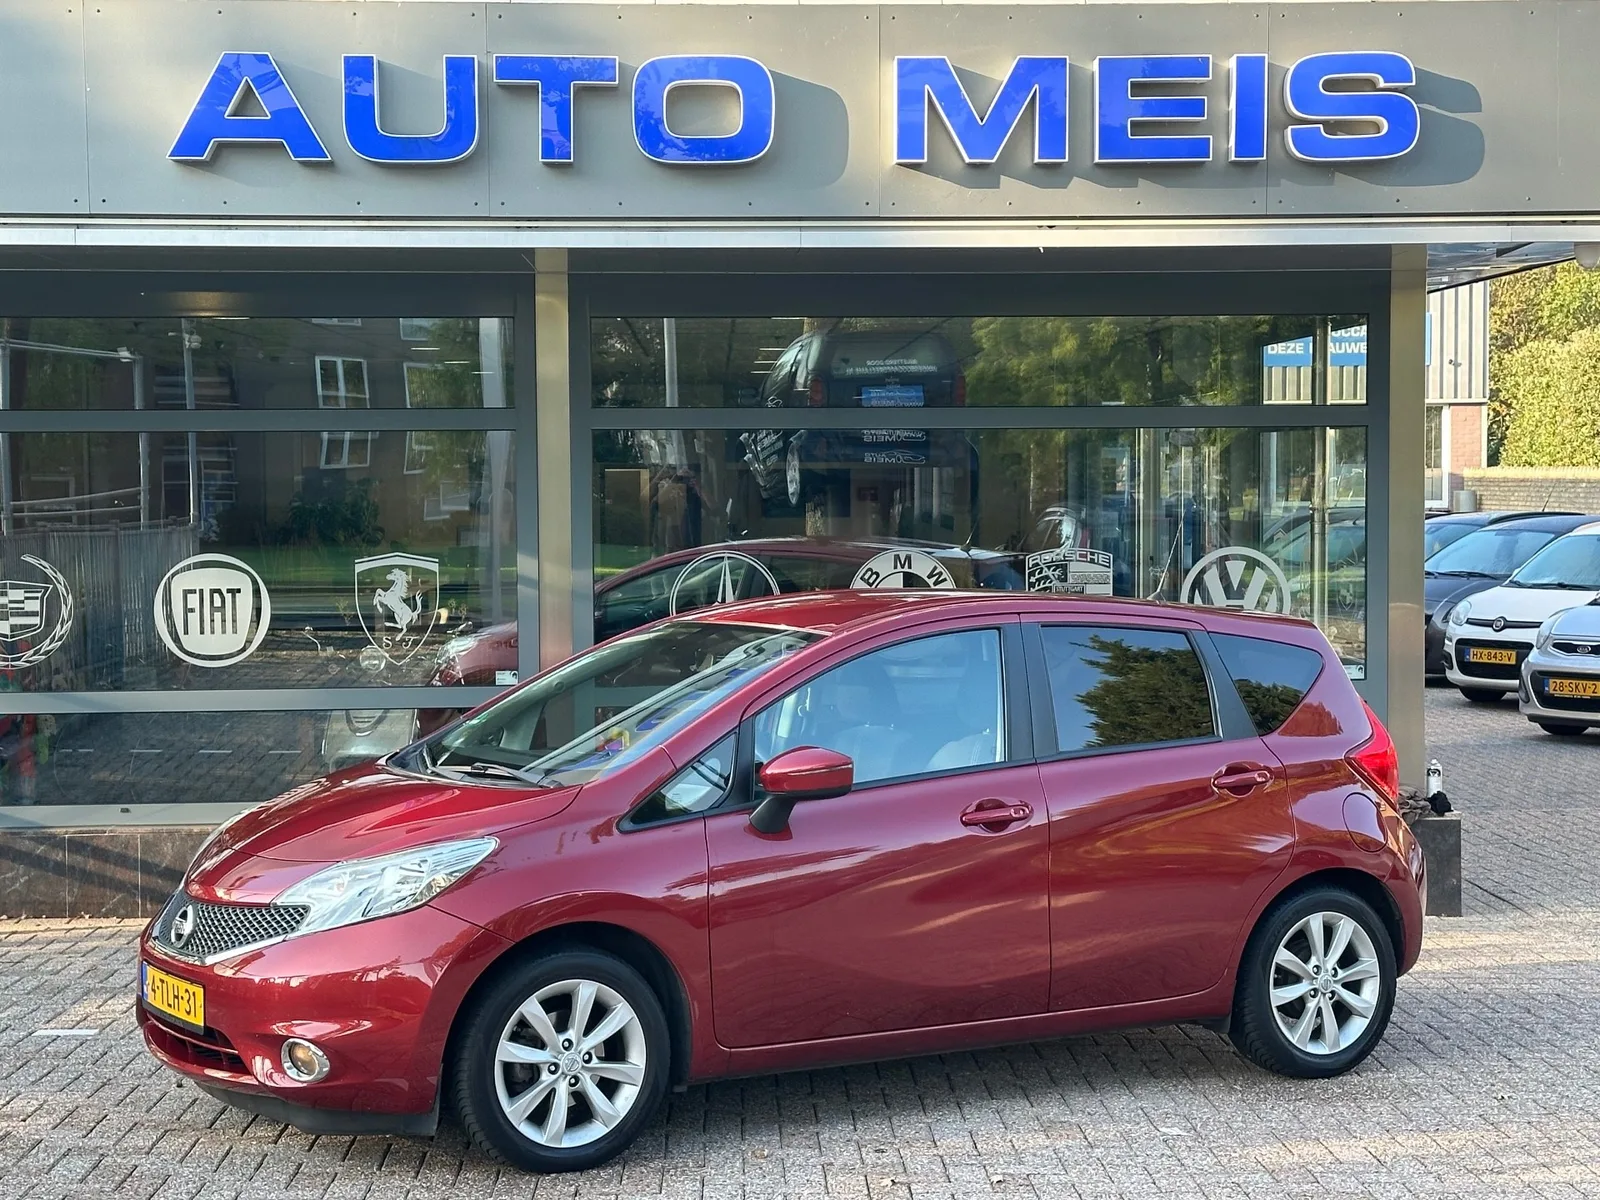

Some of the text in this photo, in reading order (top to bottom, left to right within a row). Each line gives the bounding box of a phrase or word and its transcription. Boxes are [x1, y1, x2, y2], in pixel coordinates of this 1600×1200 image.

[168, 51, 1421, 166] AUTO MEIS
[1267, 342, 1304, 354] DEZE
[859, 553, 948, 588] BMW
[1028, 551, 1110, 568] PORSCHE
[182, 587, 242, 636] FIAT
[1472, 649, 1513, 662] HX-843-V
[1552, 680, 1598, 694] 28-SKV-2
[151, 974, 197, 1018] 4-TLH-31
